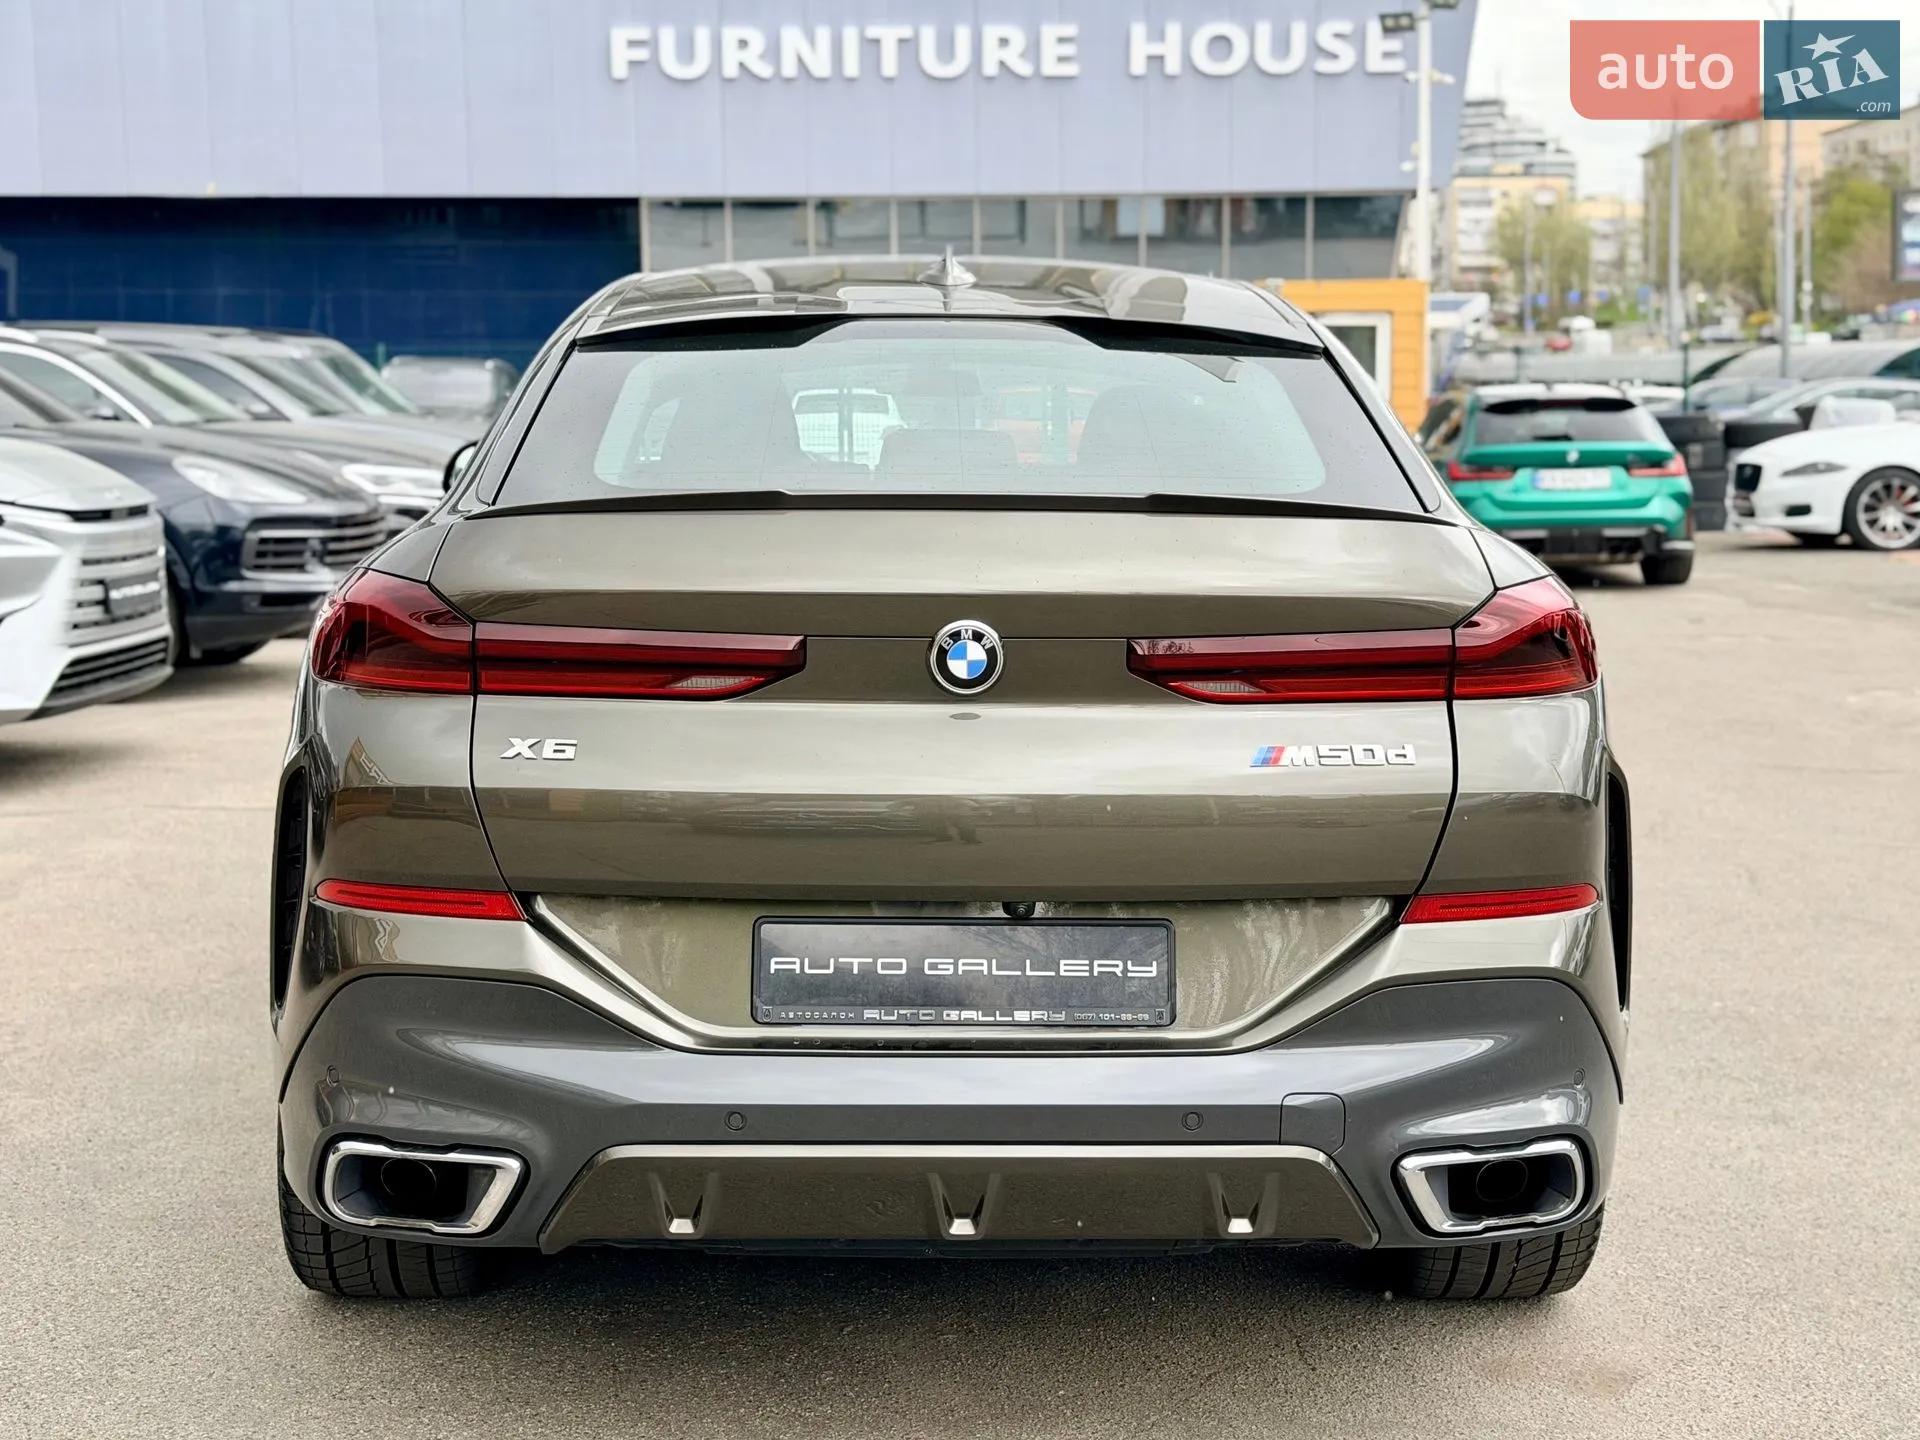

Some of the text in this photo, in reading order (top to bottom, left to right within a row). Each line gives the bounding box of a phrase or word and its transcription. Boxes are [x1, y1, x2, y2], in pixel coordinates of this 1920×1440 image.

[609, 20, 1406, 80] FURNITURE HOUSE
[941, 629, 993, 650] BMW
[499, 737, 578, 760] X6
[770, 957, 1157, 977] AUTO GALLERY
[863, 1010, 935, 1020] AUTO
[943, 1010, 1065, 1021] GALLERY
